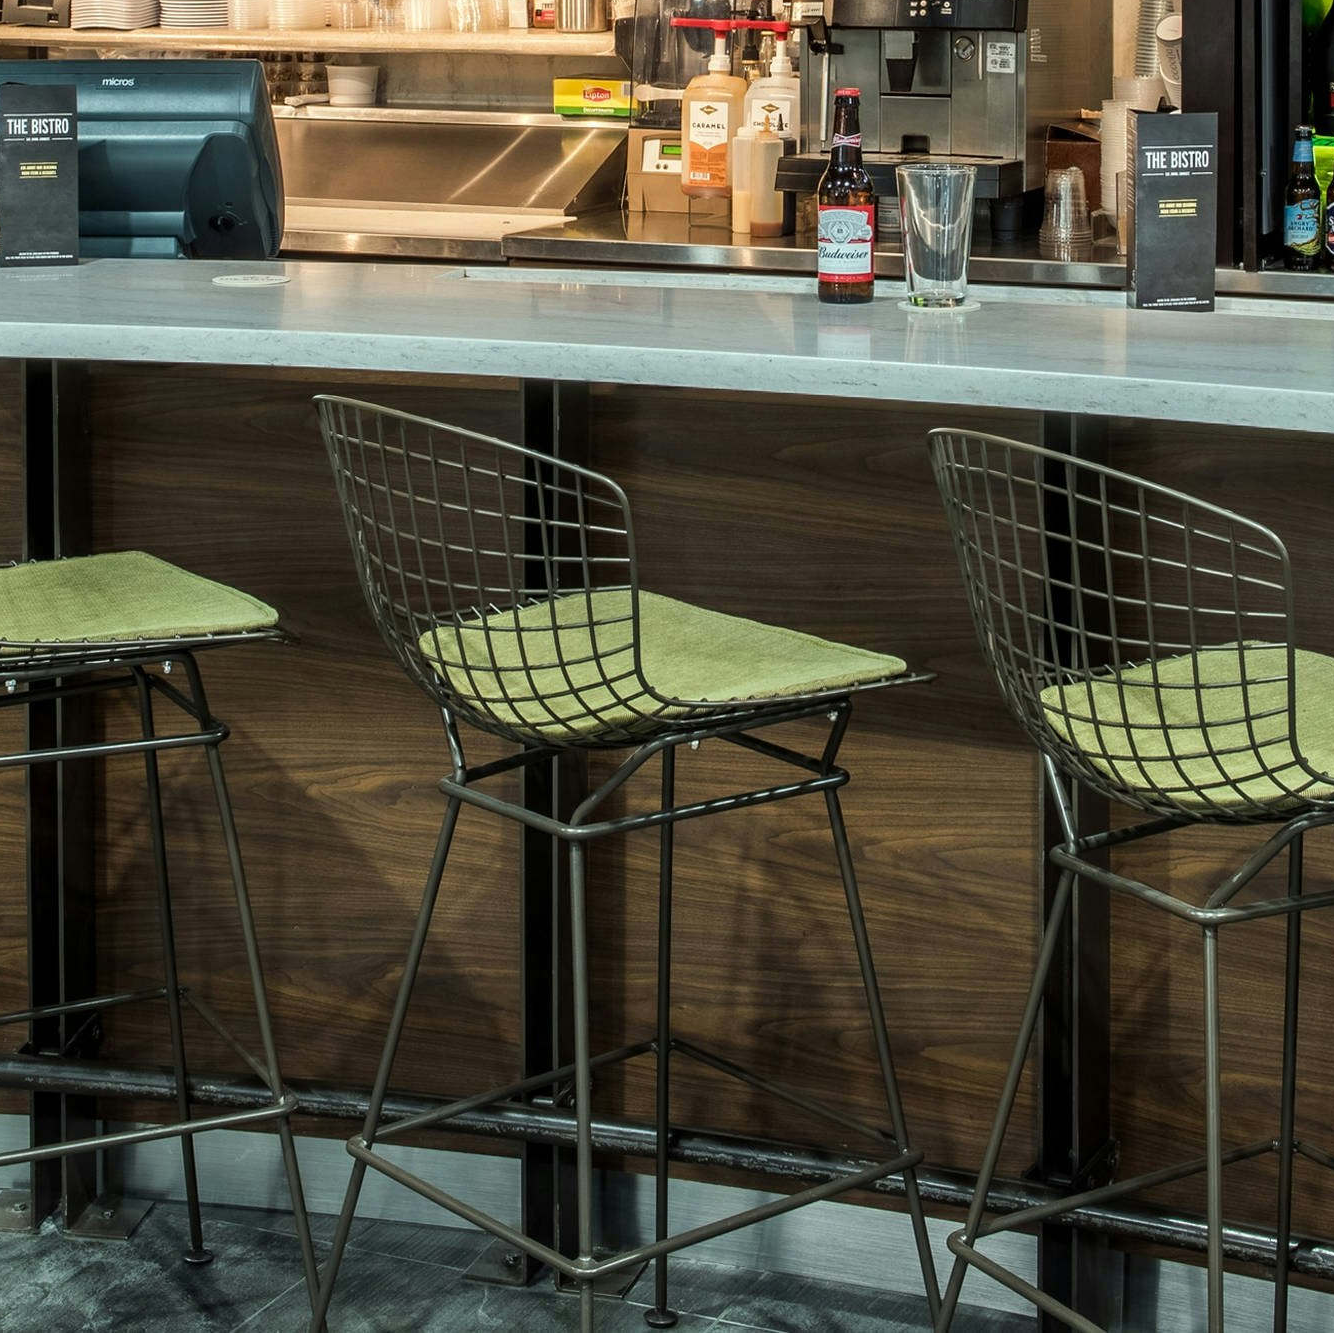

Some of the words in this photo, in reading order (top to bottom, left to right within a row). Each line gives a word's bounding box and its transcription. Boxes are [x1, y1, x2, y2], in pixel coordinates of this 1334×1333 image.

[102, 78, 135, 87] micros
[585, 91, 610, 99] Lipton
[7, 119, 28, 135] THE
[31, 117, 69, 135] BISTRO
[1145, 151, 1167, 169] THE
[1170, 150, 1209, 169] BISTRO
[818, 246, 869, 259] Budweiser
